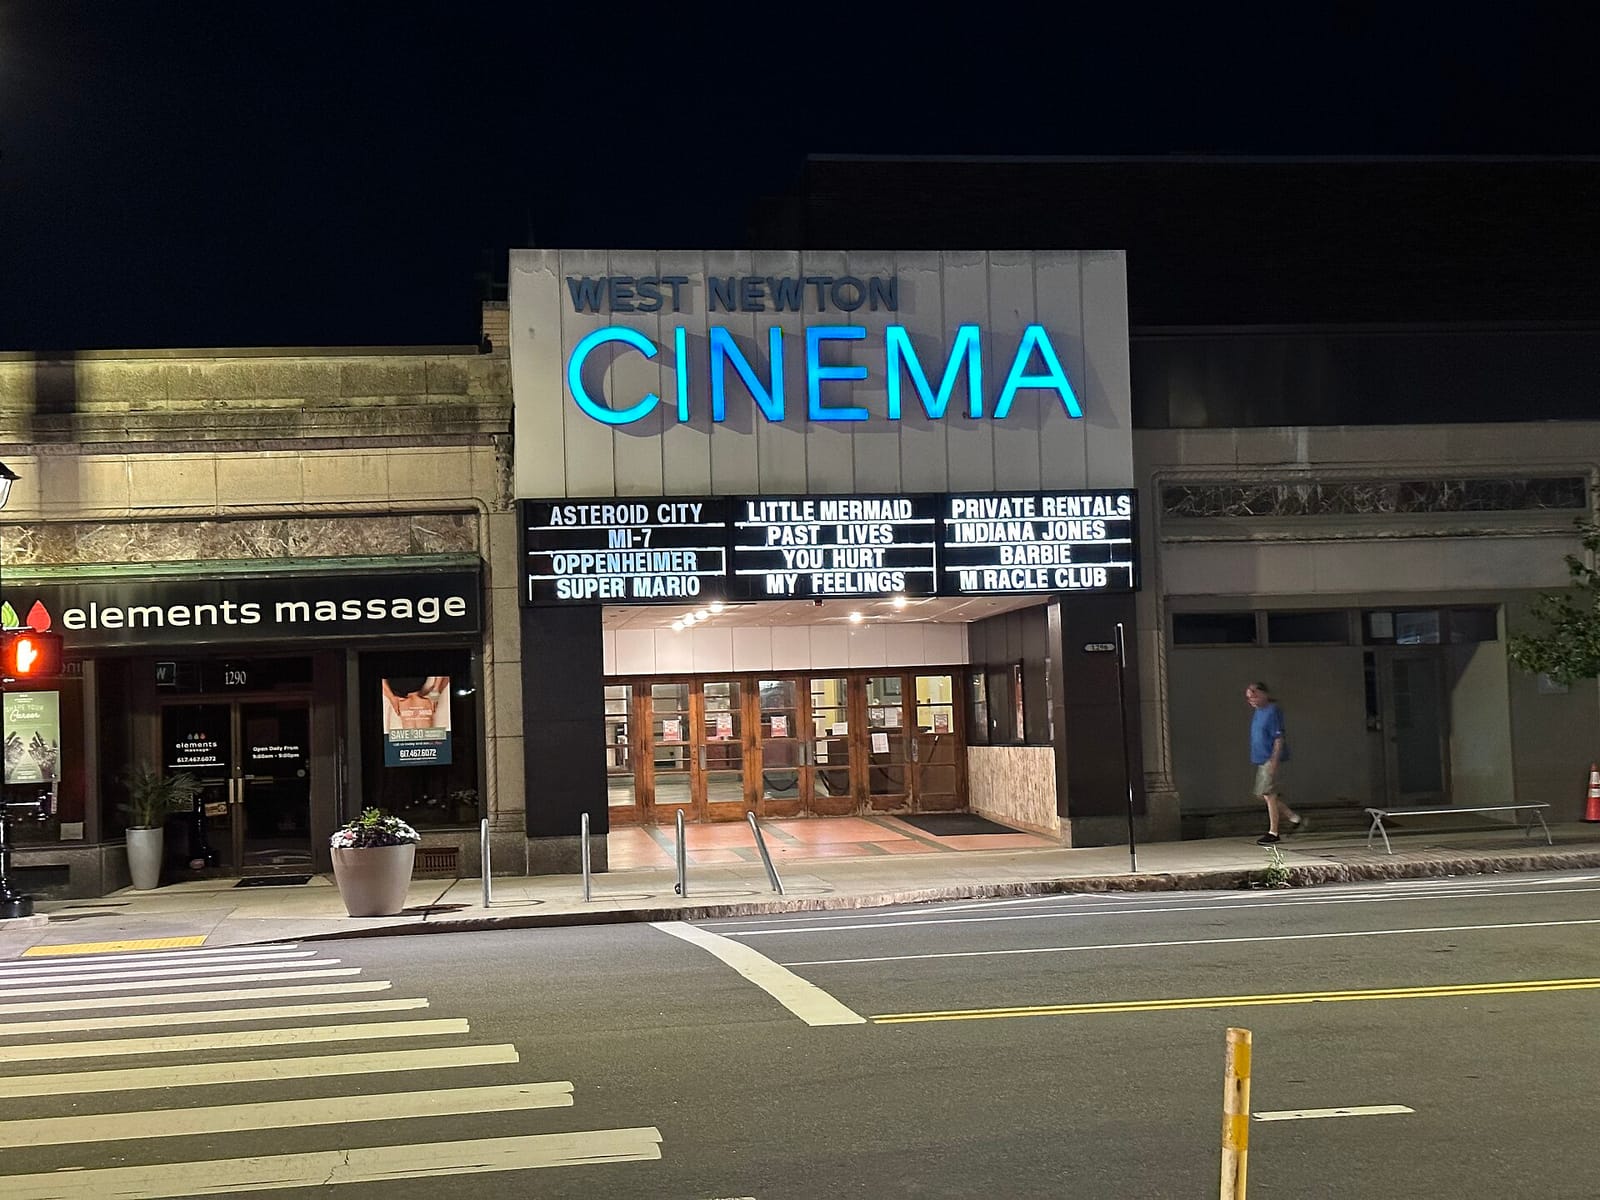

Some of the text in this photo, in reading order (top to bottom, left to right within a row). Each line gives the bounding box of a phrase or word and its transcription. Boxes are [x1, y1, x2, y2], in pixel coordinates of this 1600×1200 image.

[567, 275, 899, 313] WEST NEWTON
[567, 324, 1083, 425] CINEMA
[550, 503, 703, 526] ASTEROID CITY
[748, 500, 912, 521] LITTLE MERMAID
[951, 495, 1131, 518] PRIVATE RENTALS
[608, 529, 652, 549] MI-7
[767, 524, 894, 545] PAST LIVES
[955, 520, 1106, 543] INDIANA JONES
[553, 552, 697, 574] OPPENHEIMER
[782, 548, 886, 569] YOU HURT
[1000, 545, 1072, 565] BARBIE
[557, 576, 701, 599] SUPER MARIO
[766, 572, 905, 594] MY FEELINGS
[1054, 567, 1107, 588] CLUB
[62, 596, 467, 630] elements massage
[225, 670, 247, 685] 1290
[175, 741, 218, 749] elements
[390, 730, 410, 740] SAVE
